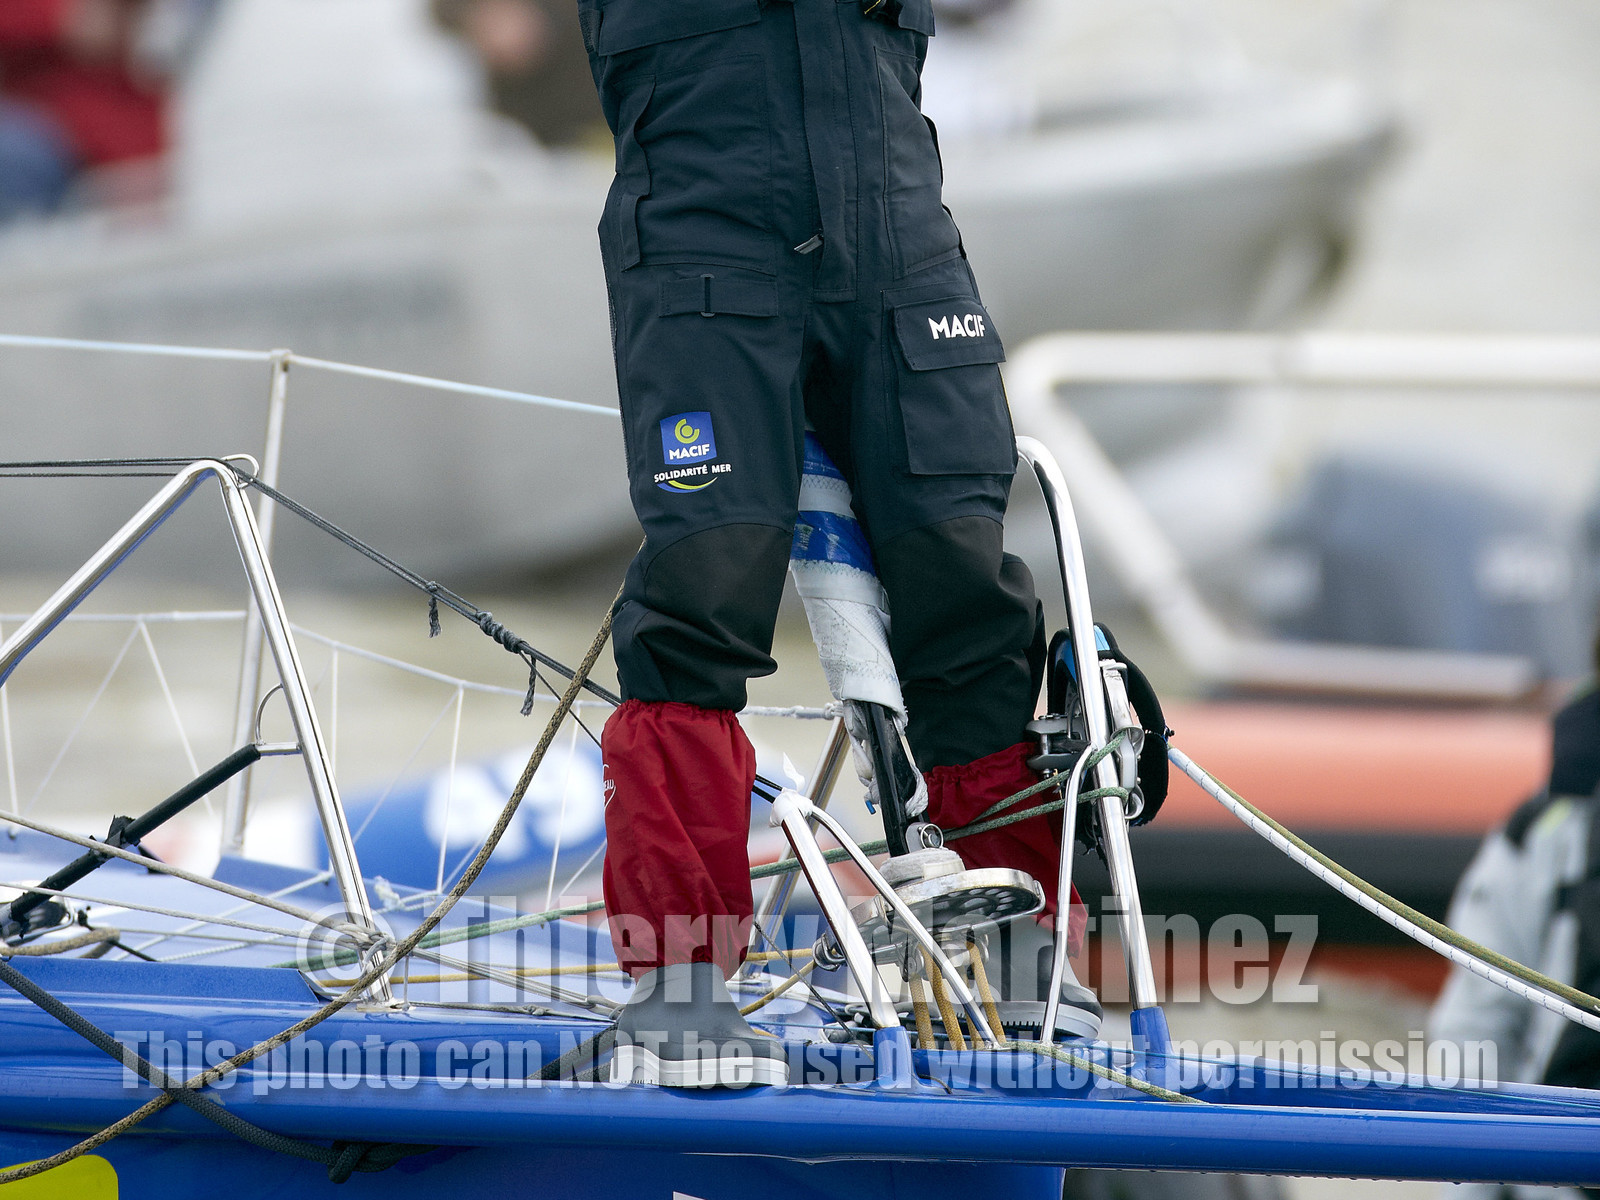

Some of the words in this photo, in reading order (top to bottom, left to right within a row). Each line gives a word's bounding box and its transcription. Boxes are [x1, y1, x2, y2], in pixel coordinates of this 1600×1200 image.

[928, 313, 986, 340] MACIF
[669, 443, 710, 460] MACIF
[653, 464, 709, 483] SOLIDARITÉ
[711, 463, 732, 474] MER
